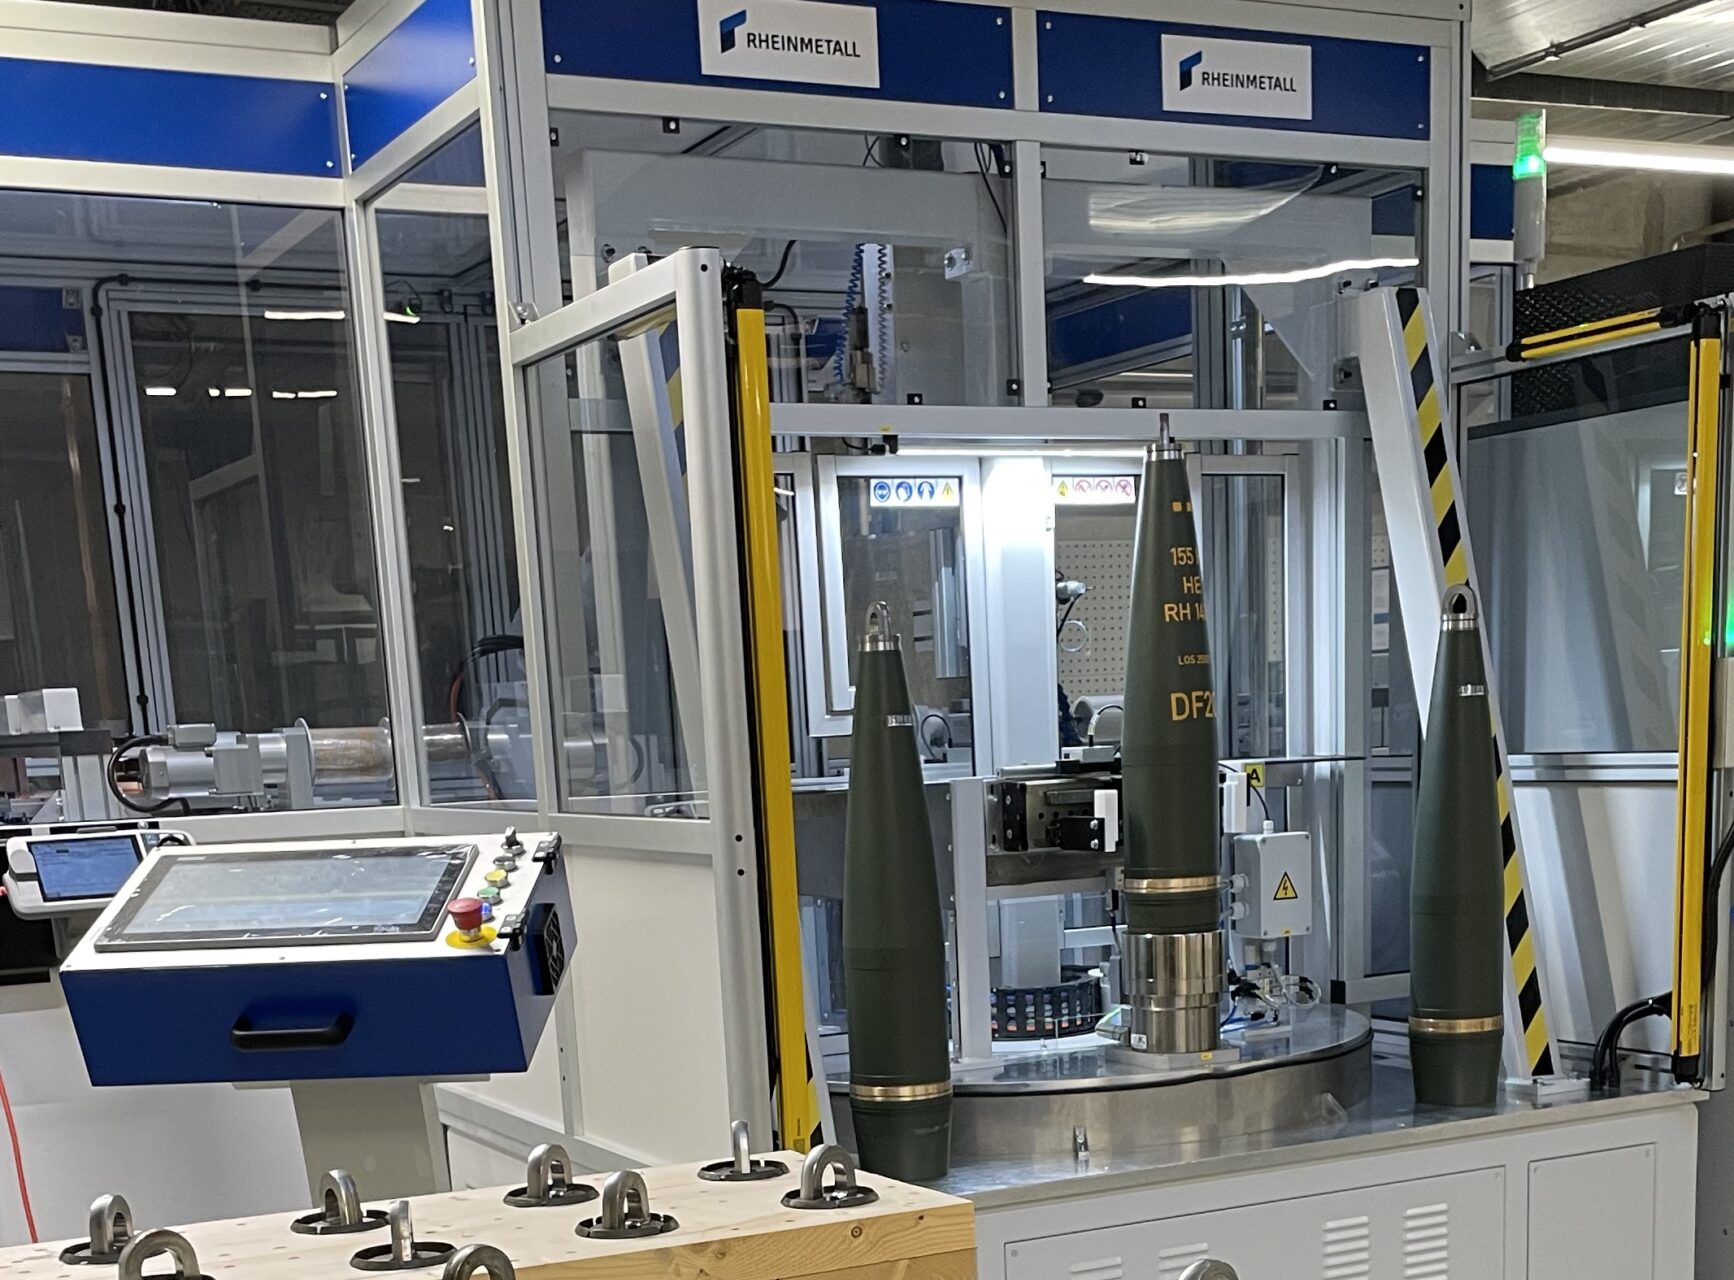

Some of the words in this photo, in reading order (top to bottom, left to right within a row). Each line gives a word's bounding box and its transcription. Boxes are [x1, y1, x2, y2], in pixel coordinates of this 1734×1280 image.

[747, 32, 861, 58] RHEINMETALL
[1201, 71, 1297, 92] RHEINMETALL
[1170, 547, 1195, 566] 155
[1182, 575, 1203, 594] HE
[1164, 603, 1191, 622] RH
[1178, 655, 1196, 665] LOS
[1170, 690, 1216, 722] DF2
[1249, 767, 1262, 783] A
